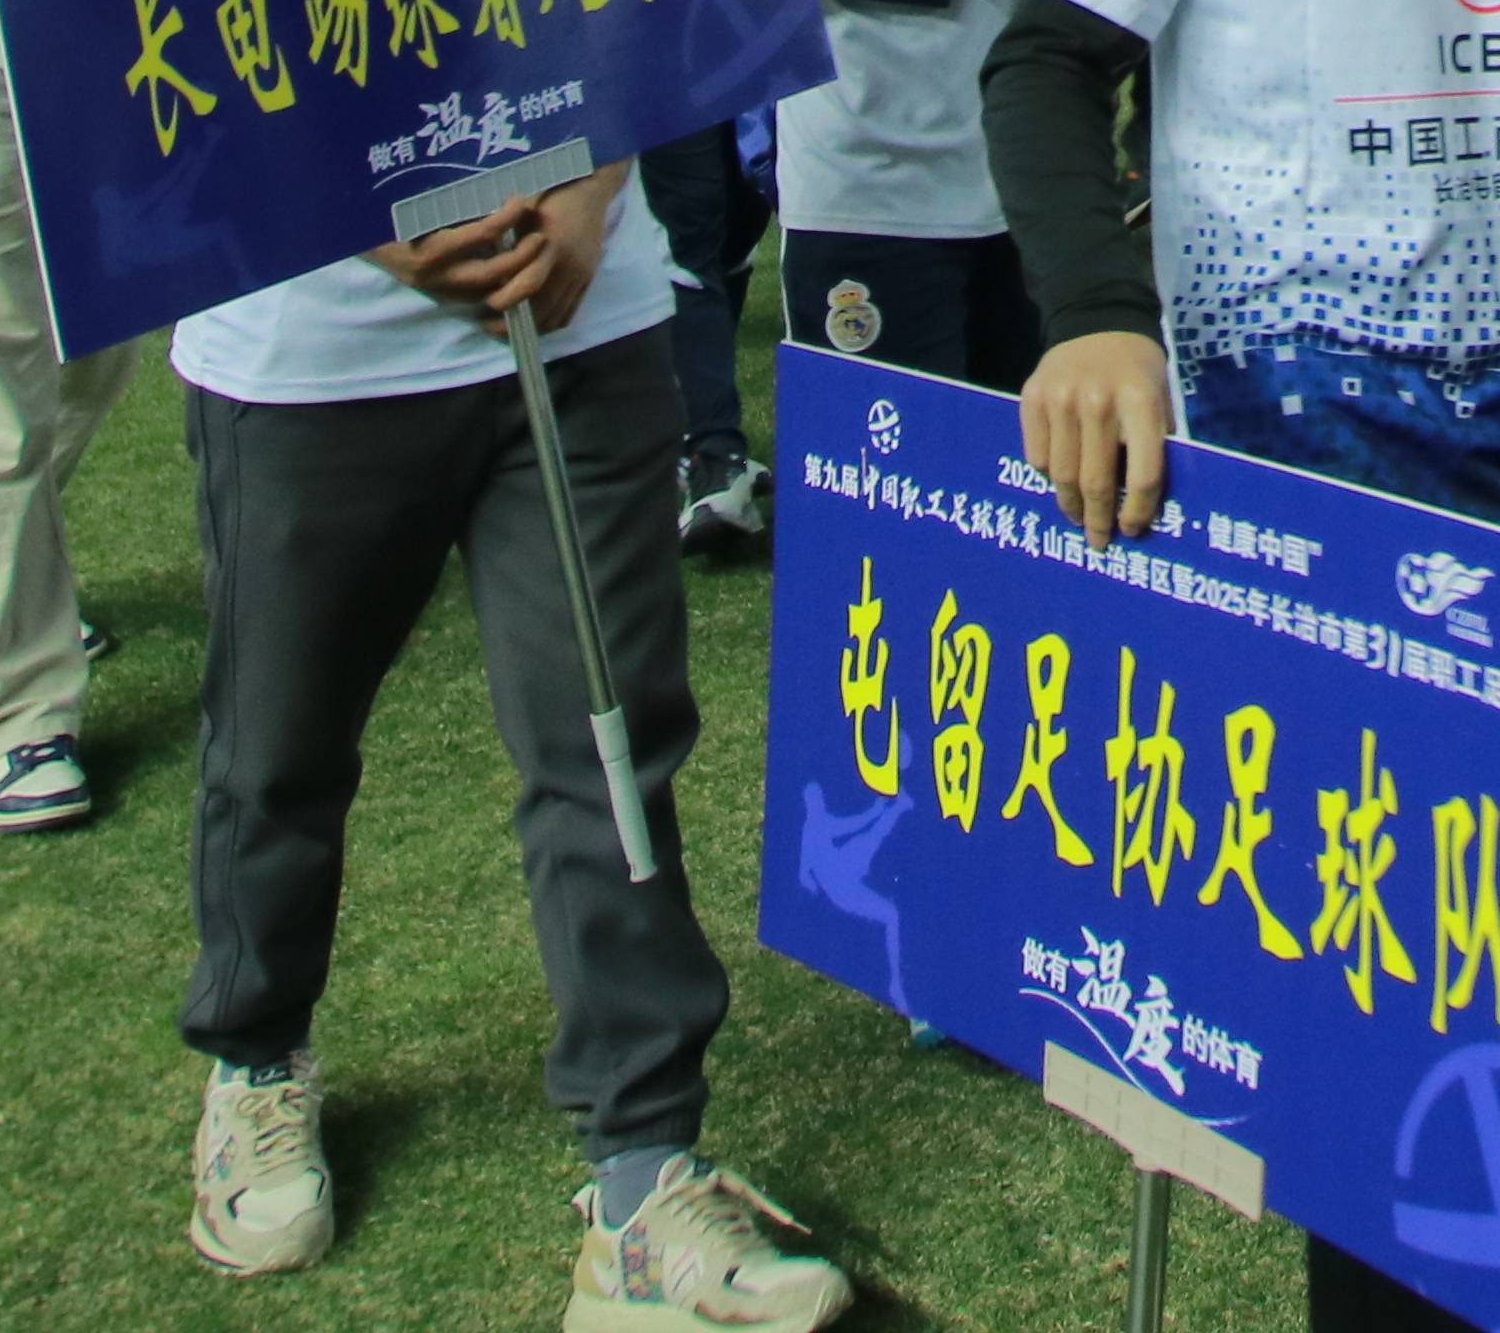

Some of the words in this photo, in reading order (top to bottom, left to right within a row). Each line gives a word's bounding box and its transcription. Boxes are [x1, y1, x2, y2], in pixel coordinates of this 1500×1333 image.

[367, 80, 584, 175] 做有温度的体育
[997, 455, 1058, 496] 2025
[1021, 925, 1263, 1097] 做有温度的体育
